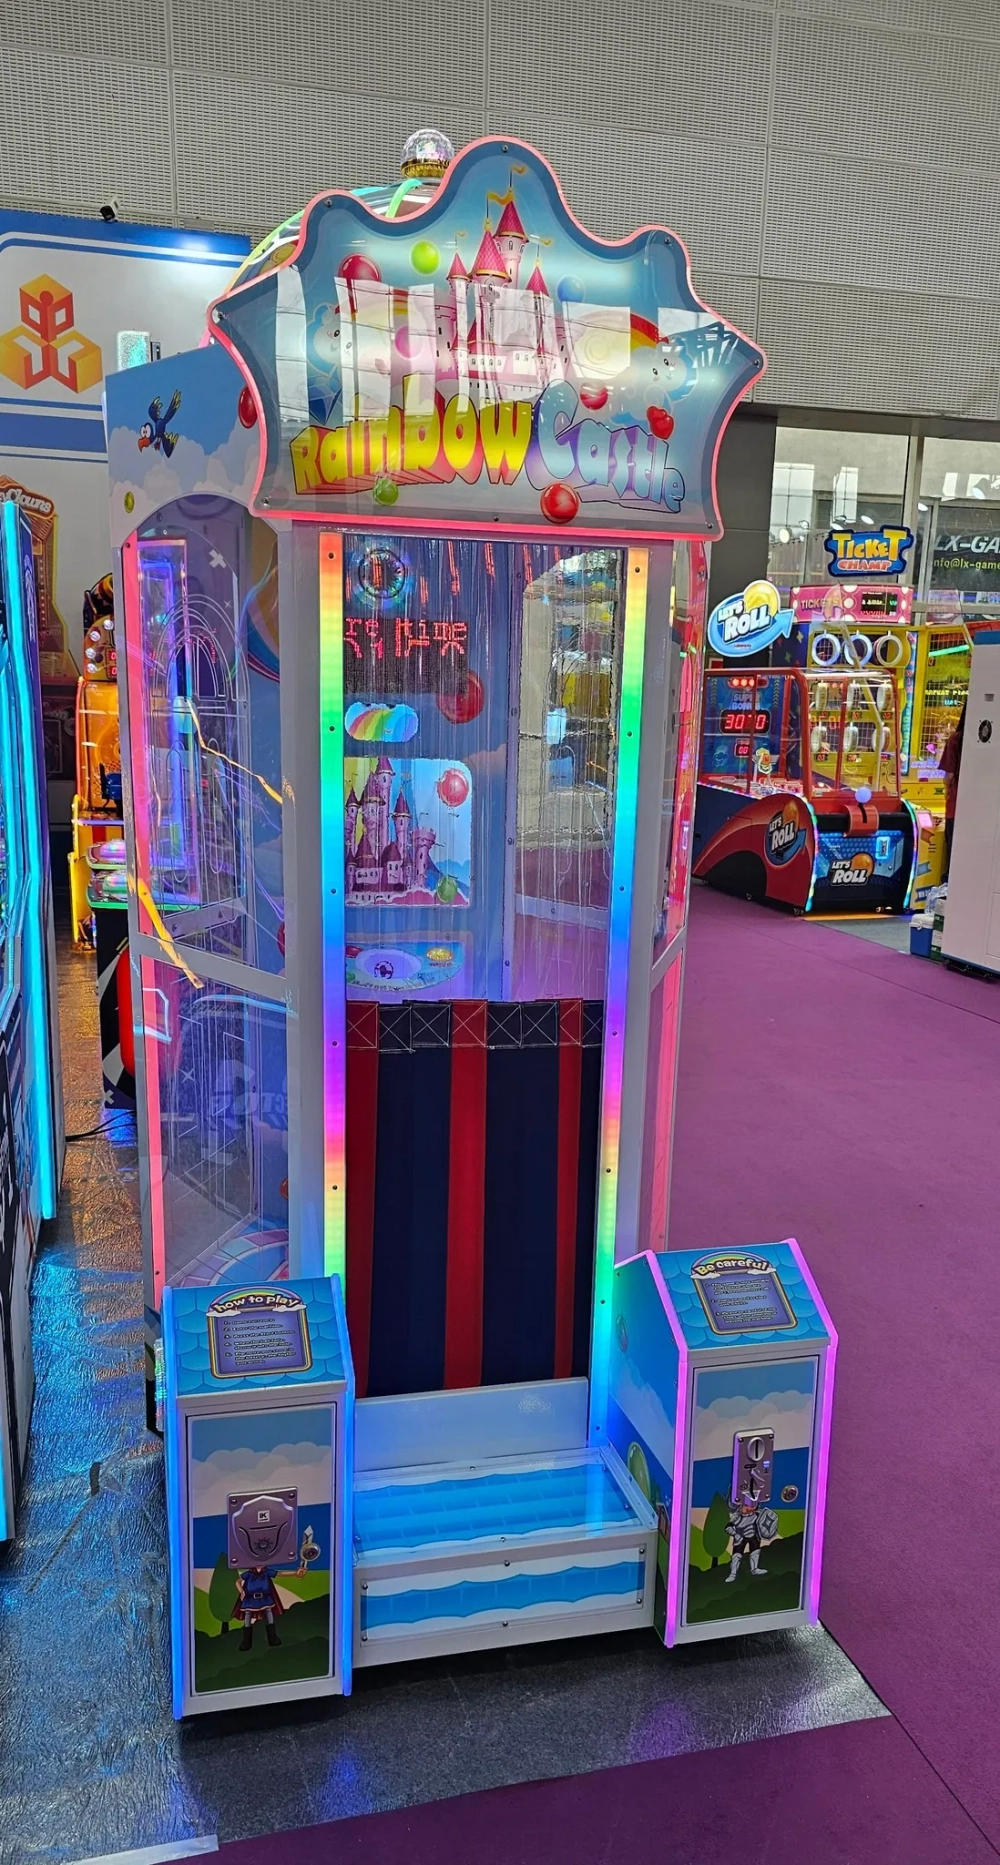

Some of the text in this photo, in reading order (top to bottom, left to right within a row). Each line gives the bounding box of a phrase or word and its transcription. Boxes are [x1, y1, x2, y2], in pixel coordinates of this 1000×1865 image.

[527, 379, 686, 512] Castle
[934, 535, 1000, 553] LX-GA
[837, 559, 892, 572] CHAMP
[717, 600, 743, 622] LET'S
[724, 605, 770, 641] ROLL
[731, 702, 761, 710] BONS
[733, 693, 762, 702] SUPR
[769, 816, 782, 832] LET'S
[771, 821, 795, 851] ROLL
[831, 861, 851, 869] LET'S
[832, 869, 866, 883] ROLL
[695, 1258, 768, 1275] Be careful
[214, 1295, 299, 1312] how to play
